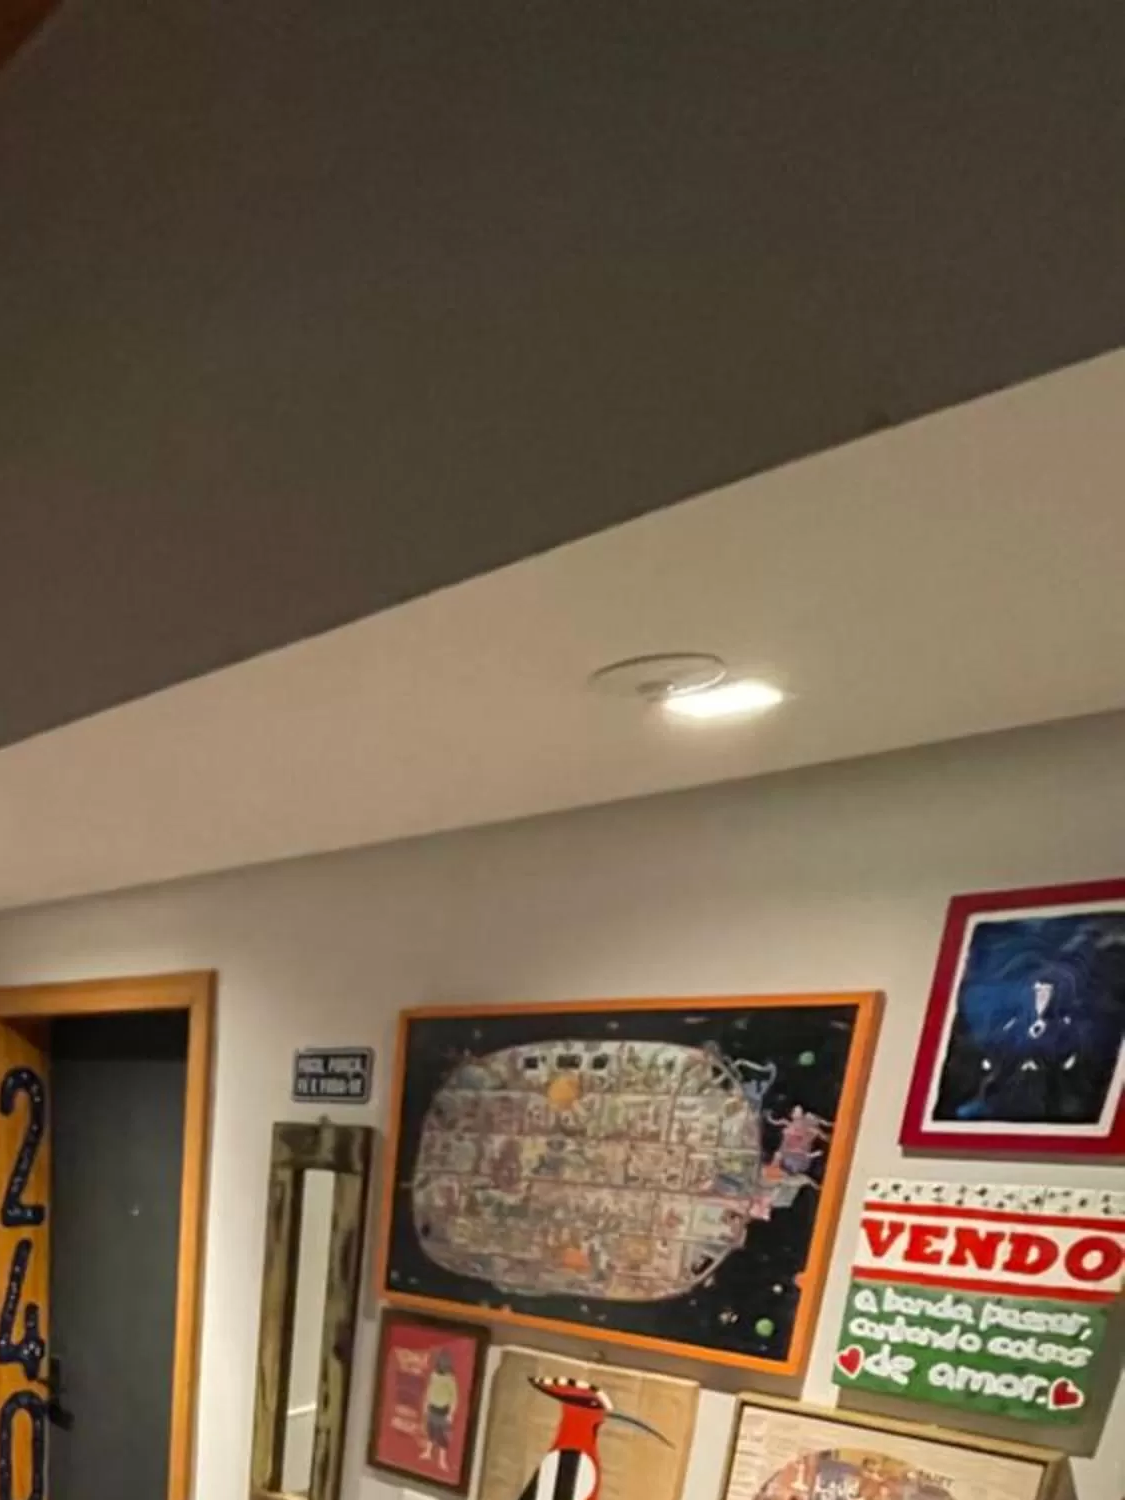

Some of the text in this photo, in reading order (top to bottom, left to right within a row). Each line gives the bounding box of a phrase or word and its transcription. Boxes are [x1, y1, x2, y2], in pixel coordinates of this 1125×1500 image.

[861, 1219, 1123, 1282] VENDO
[883, 1287, 975, 1324] banda
[848, 1316, 1094, 1368] cantando coisas
[864, 1344, 916, 1385] de
